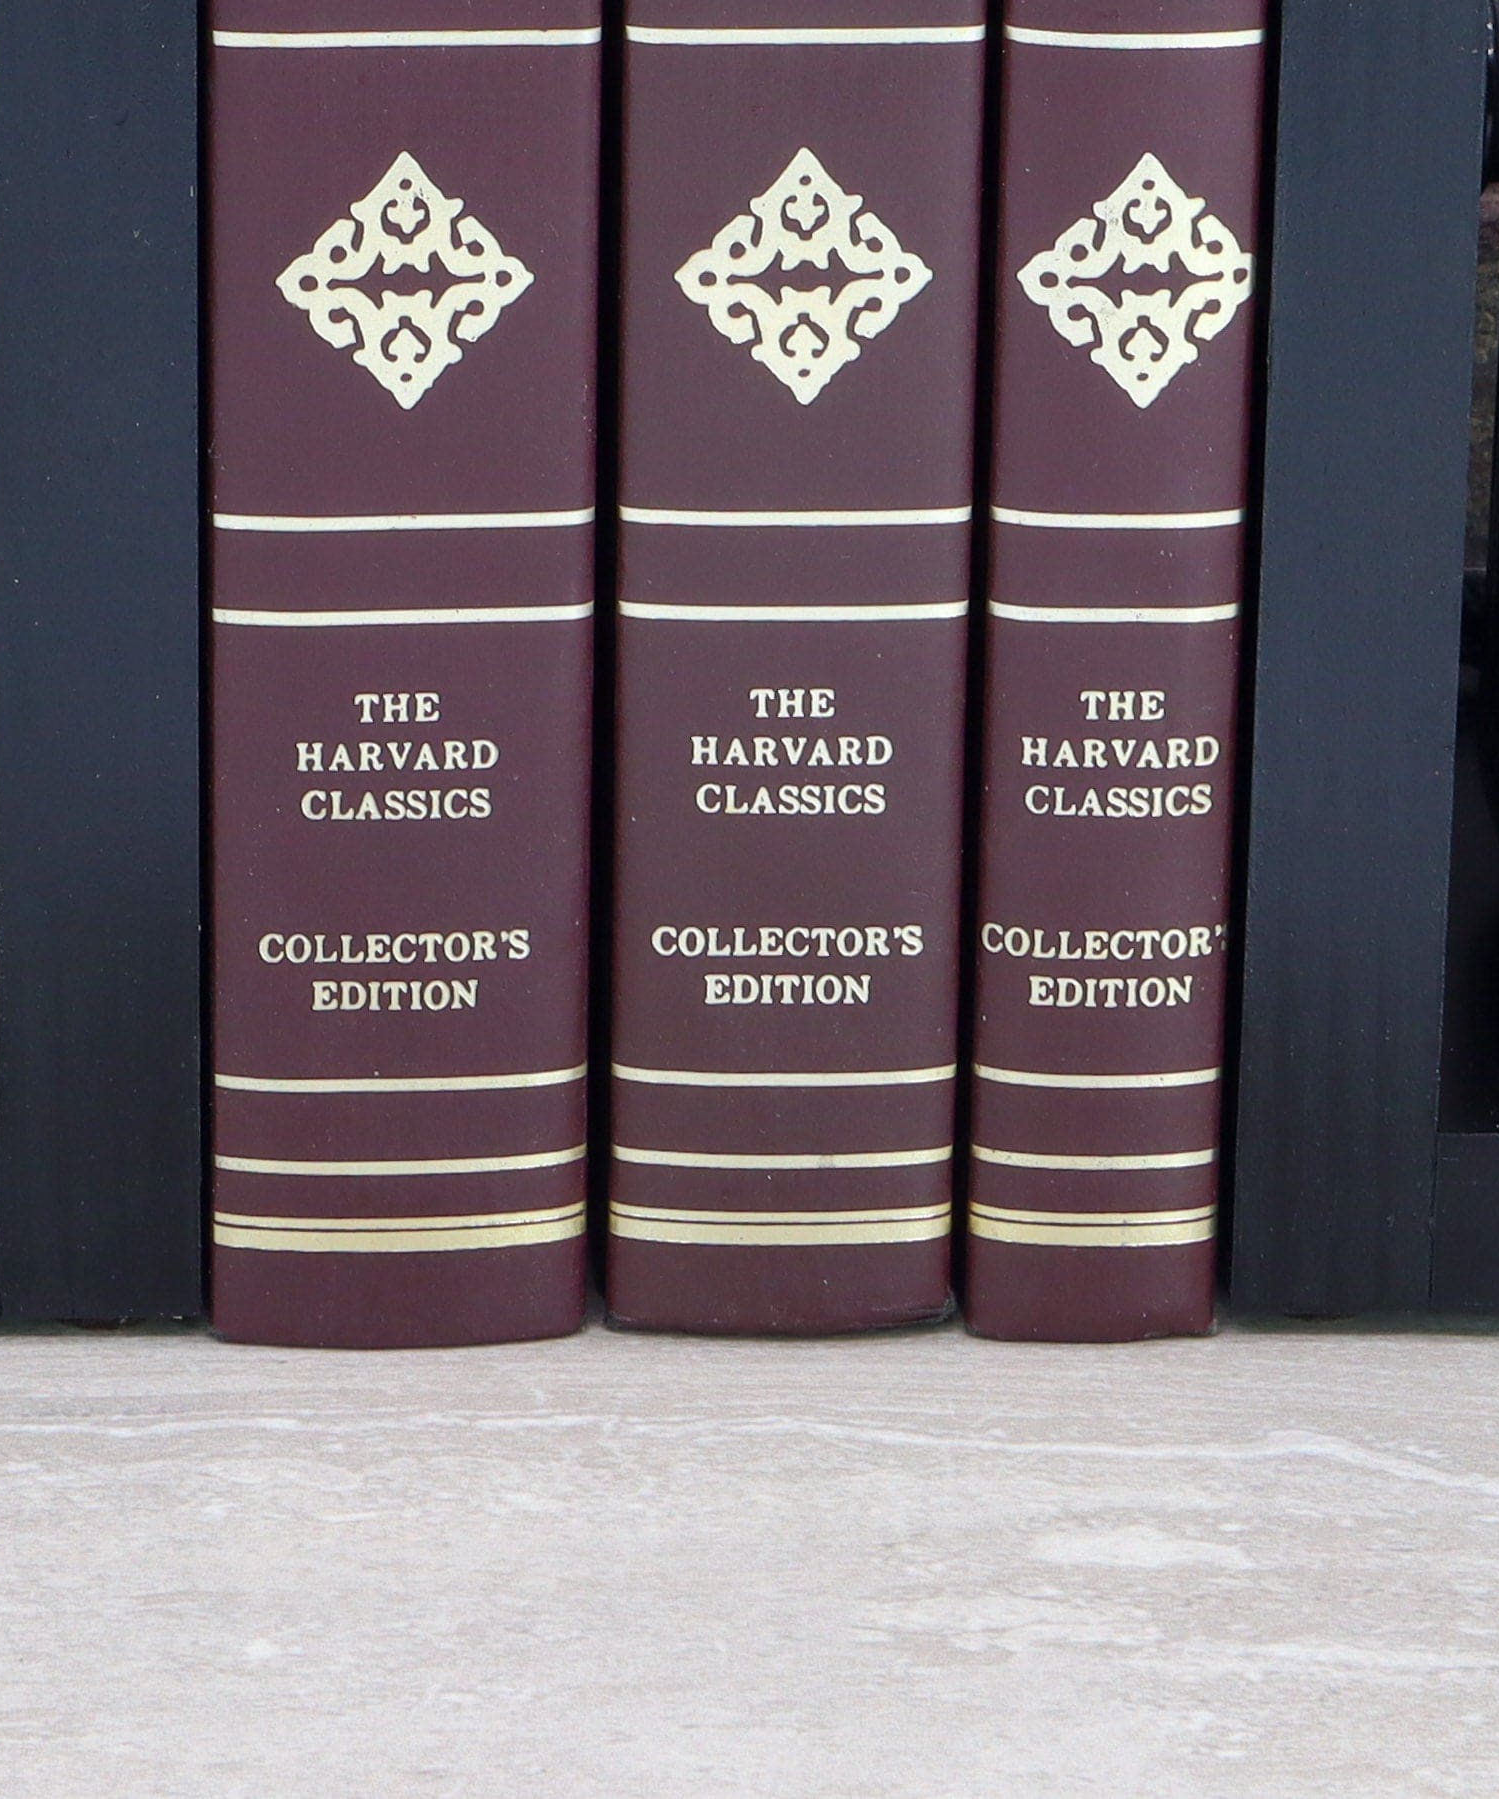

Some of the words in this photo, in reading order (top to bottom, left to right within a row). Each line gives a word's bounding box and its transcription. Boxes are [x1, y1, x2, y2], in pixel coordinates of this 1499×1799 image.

[353, 691, 441, 724] THE
[748, 687, 836, 719] THE
[1079, 689, 1166, 722] THE
[295, 738, 500, 773] HARVARD
[689, 734, 894, 768] HARVARD
[1020, 734, 1220, 770] HARVARD
[300, 786, 493, 822] CLASSICS
[695, 782, 887, 816] CLASSICS
[1024, 783, 1213, 819] CLASSICS
[257, 928, 531, 965] COLLECTOR'S
[650, 924, 925, 958] COLLECTOR'S
[980, 921, 1228, 962] COLLECTOR'
[311, 978, 480, 1012] EDITION
[703, 973, 872, 1006] EDITION
[1027, 974, 1194, 1009] EDITION
